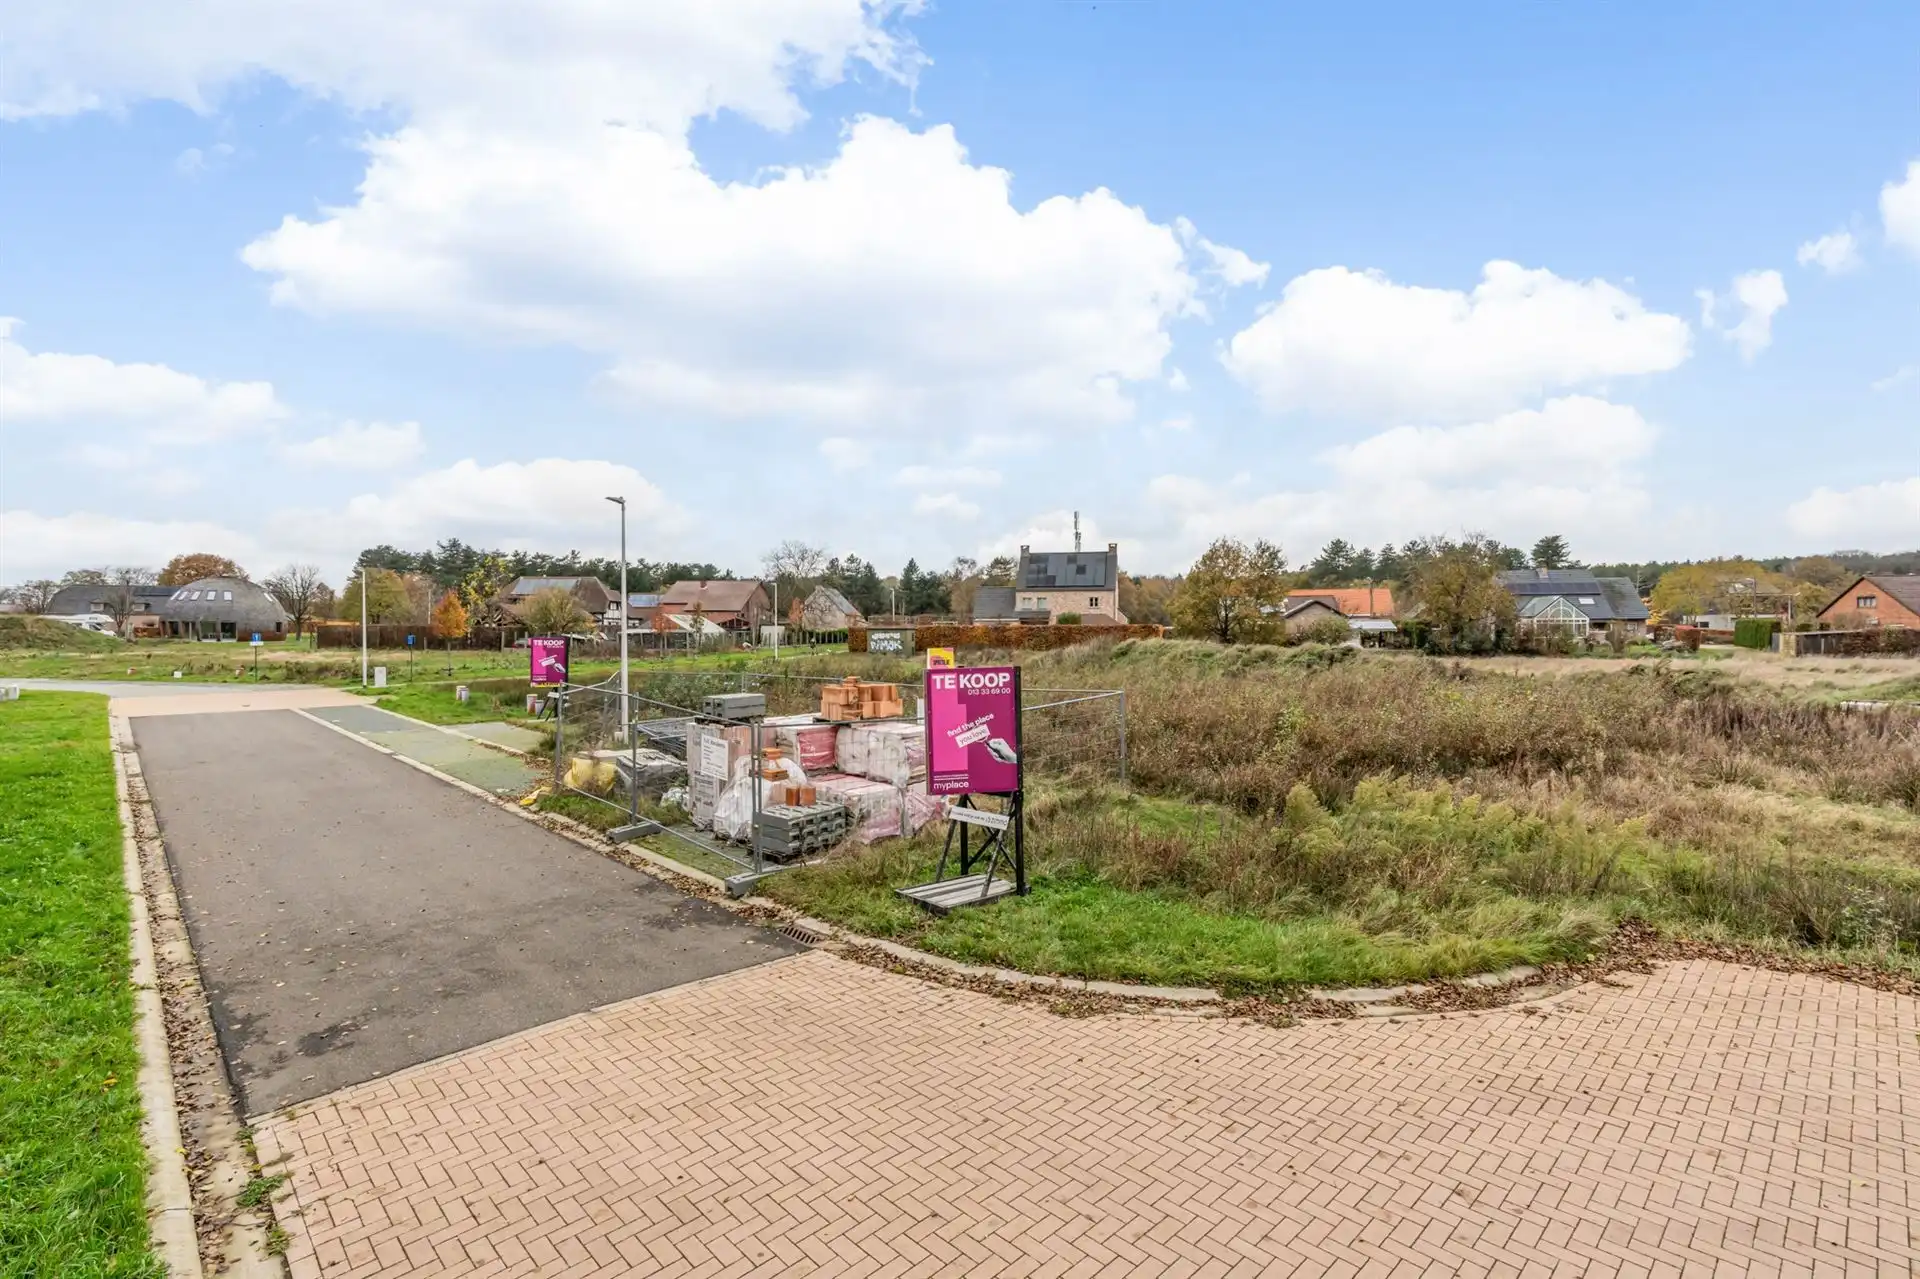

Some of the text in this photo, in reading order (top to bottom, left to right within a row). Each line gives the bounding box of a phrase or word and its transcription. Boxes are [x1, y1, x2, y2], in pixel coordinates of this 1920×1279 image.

[932, 673, 1010, 689] TE KOOP
[947, 713, 994, 737] find the place
[960, 728, 986, 745] you love
[933, 781, 969, 790] myplace
